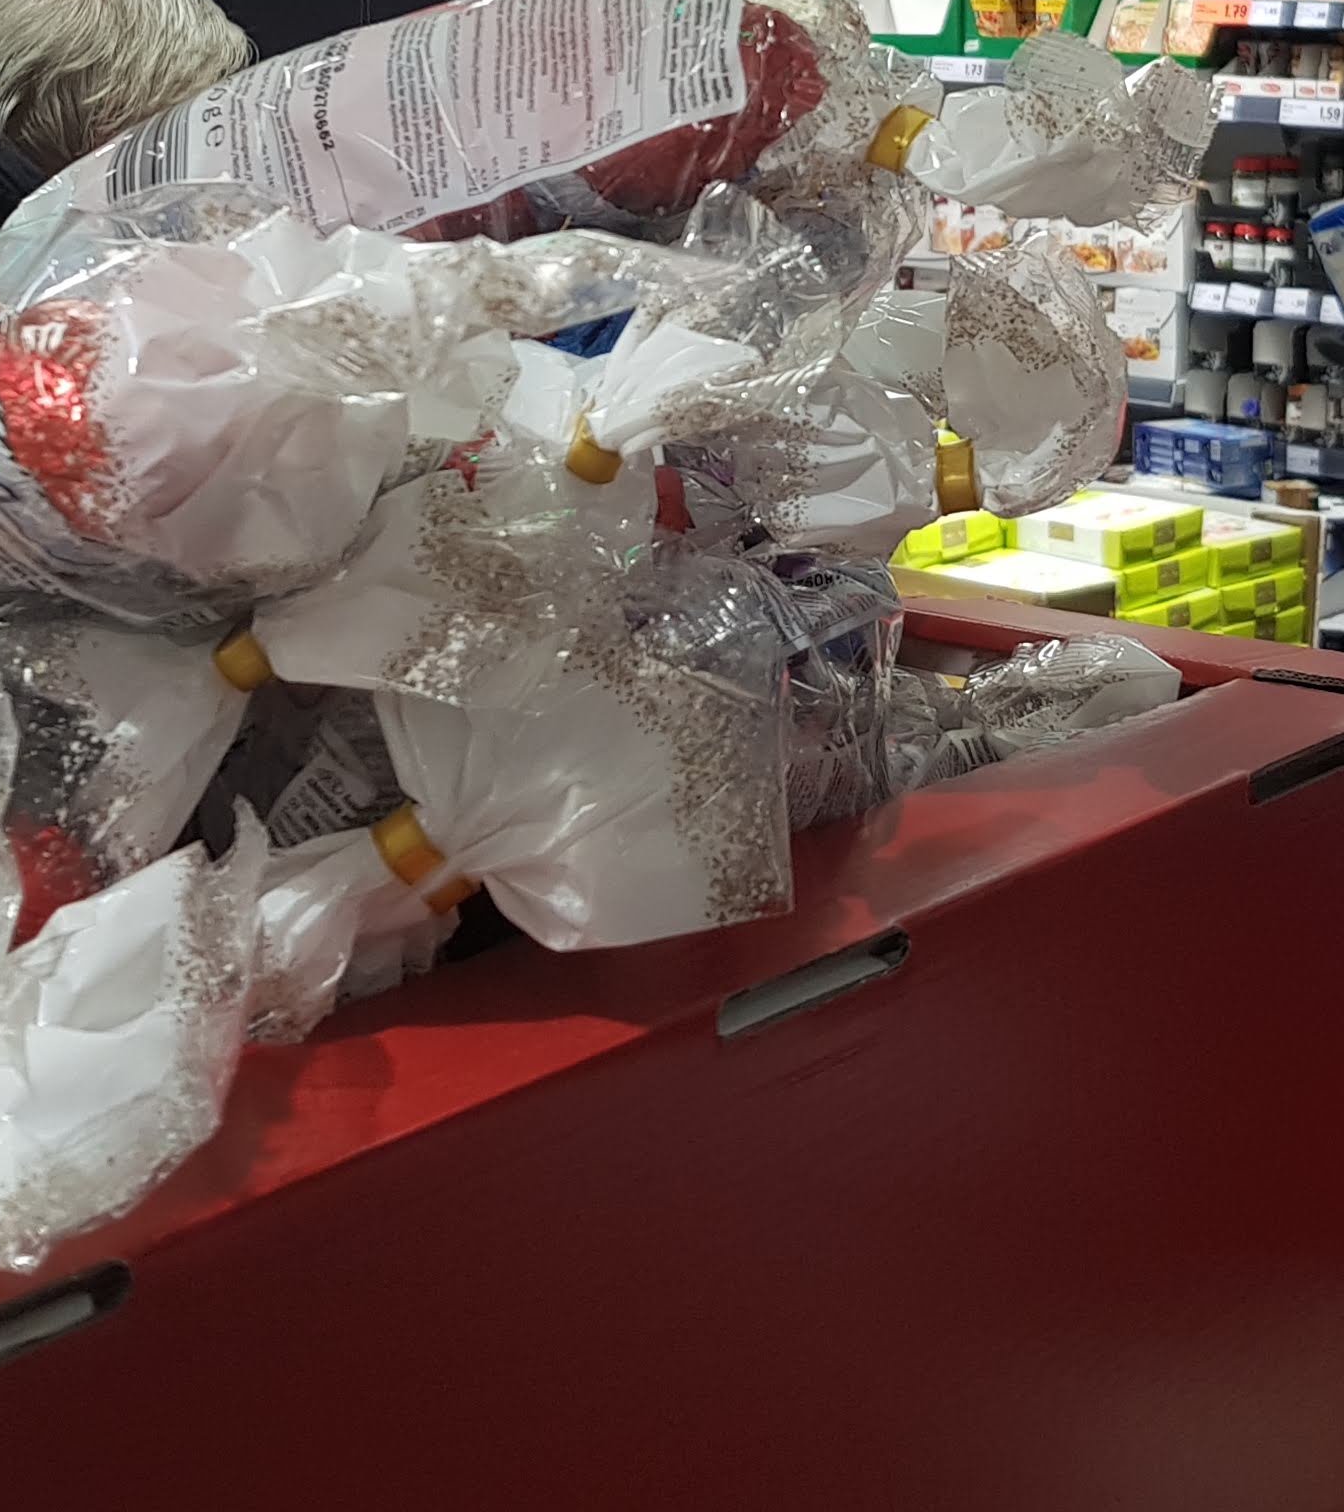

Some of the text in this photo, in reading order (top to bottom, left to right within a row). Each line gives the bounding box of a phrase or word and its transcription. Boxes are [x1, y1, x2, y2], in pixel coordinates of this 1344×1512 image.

[1224, 4, 1248, 18] 1.79
[965, 63, 983, 76] 1.73
[1320, 106, 1341, 120] 1.59
